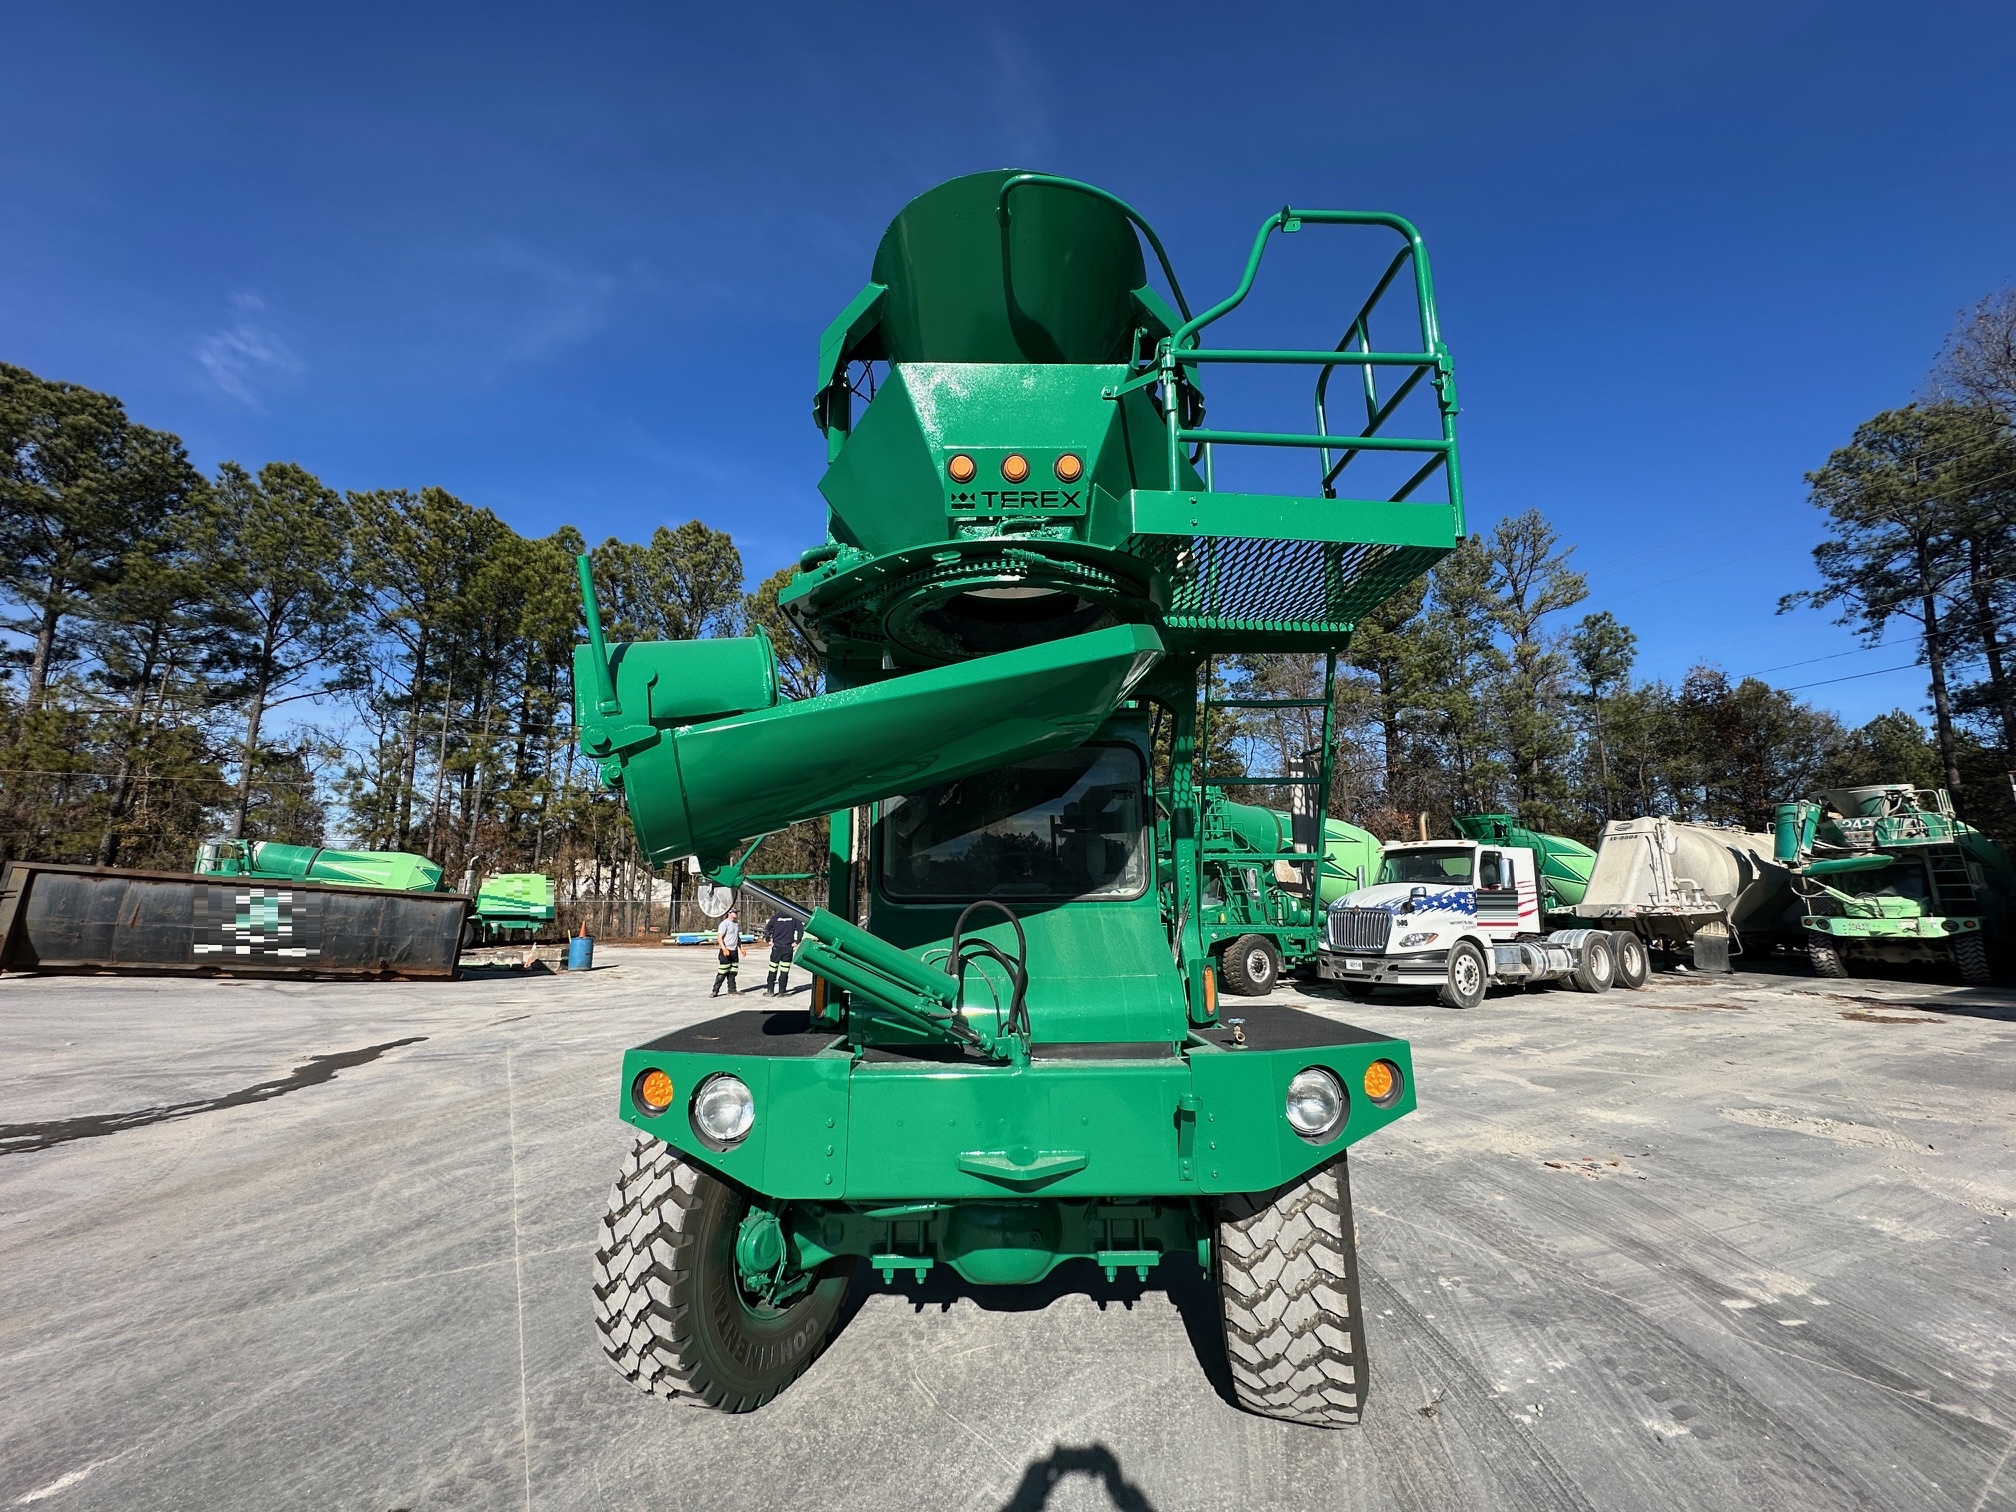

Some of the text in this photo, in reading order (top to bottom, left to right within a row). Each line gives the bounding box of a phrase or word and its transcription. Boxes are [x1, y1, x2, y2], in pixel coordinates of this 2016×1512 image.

[980, 490, 1081, 509] TEREX
[1840, 818, 1872, 829] 242
[1848, 921, 1871, 931] 242
[710, 1274, 818, 1371] CONTINENTAL
